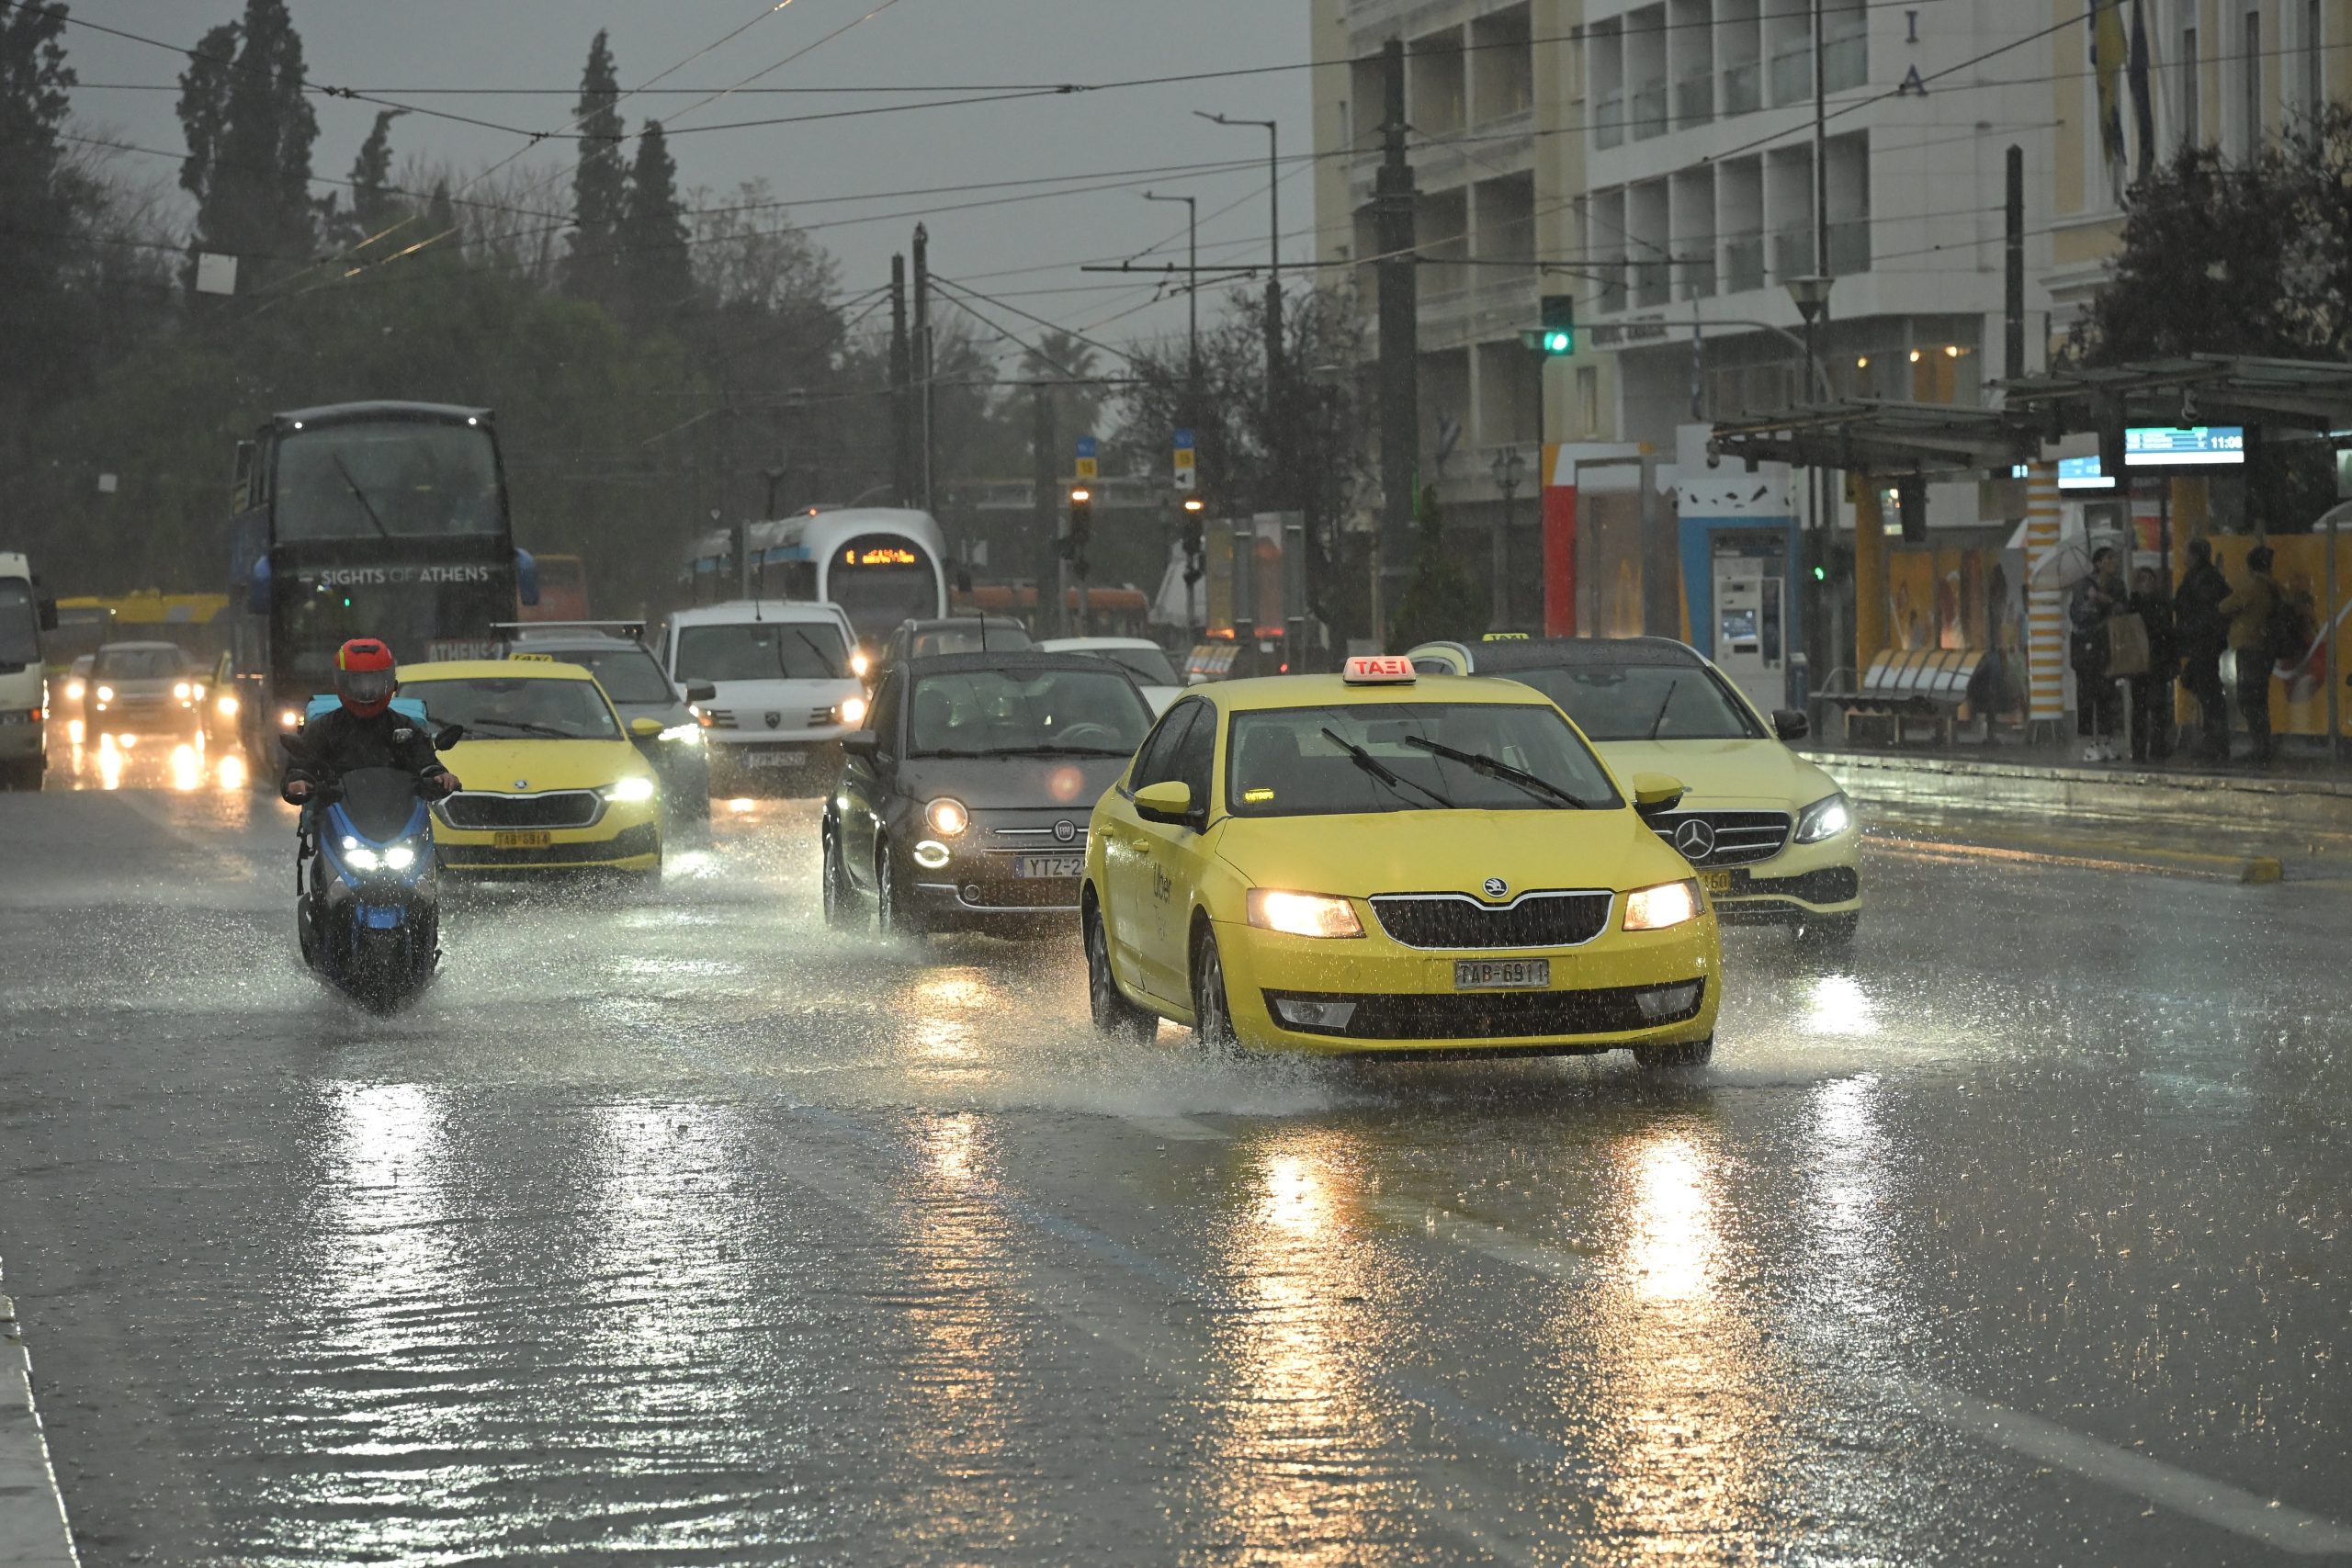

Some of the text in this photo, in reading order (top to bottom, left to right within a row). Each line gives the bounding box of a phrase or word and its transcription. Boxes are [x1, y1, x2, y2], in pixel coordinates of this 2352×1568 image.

[322, 565, 490, 585] SIGHTS OF ATHENS
[1353, 660, 1407, 675] ΤΑΞΙ
[1030, 858, 1085, 876] YTZ-2
[1153, 862, 1171, 905] Uber
